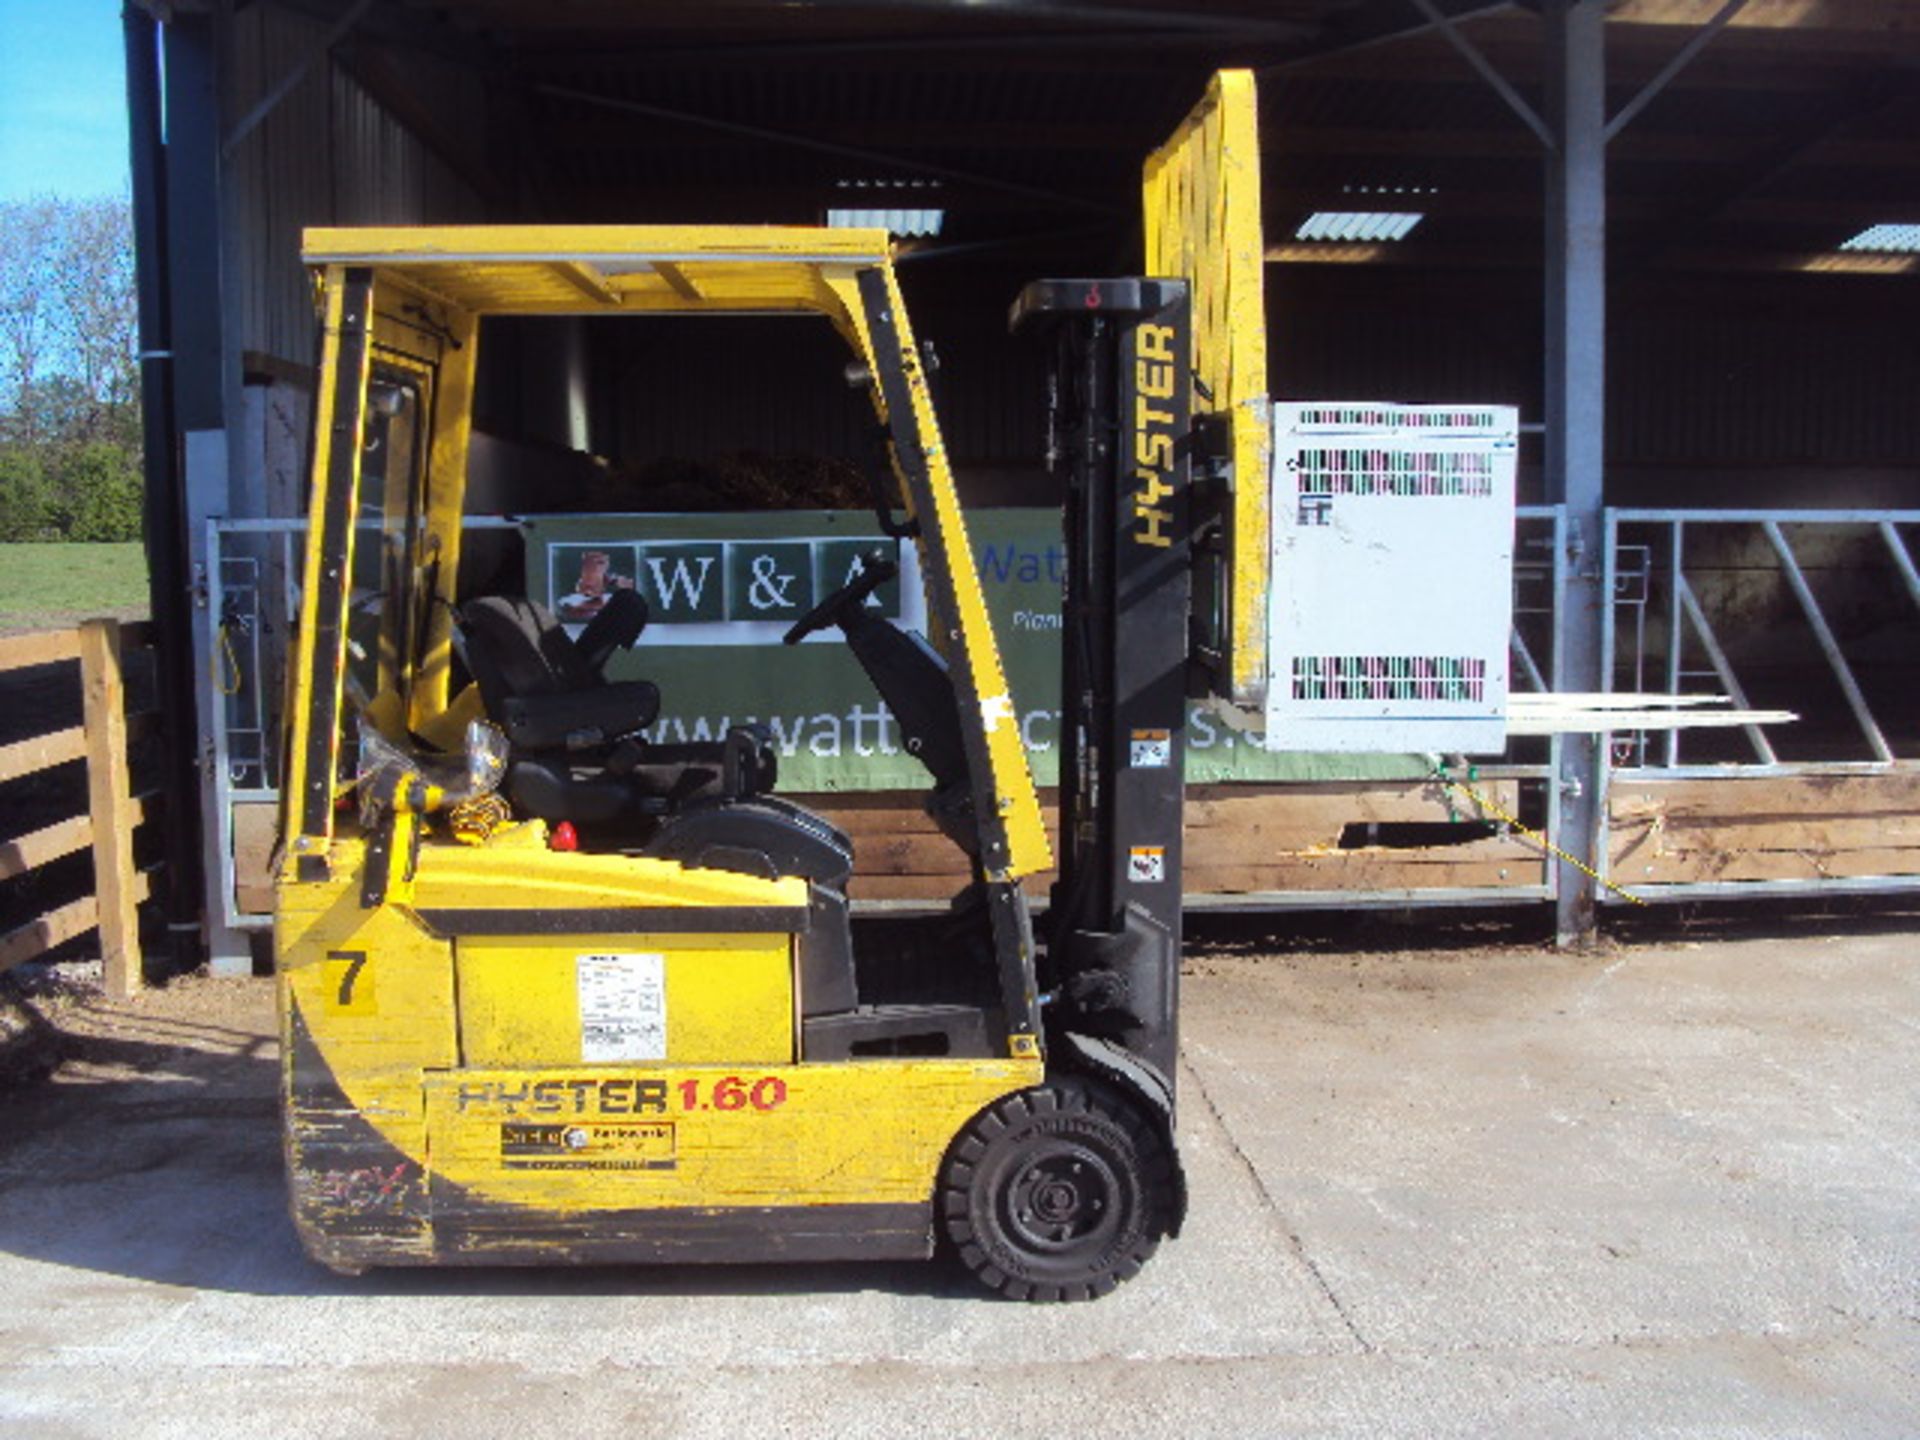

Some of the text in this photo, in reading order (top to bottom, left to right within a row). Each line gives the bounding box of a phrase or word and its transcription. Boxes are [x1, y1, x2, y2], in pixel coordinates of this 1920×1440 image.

[1135, 322, 1175, 547] HYSTER
[646, 556, 714, 611] W
[749, 553, 796, 610] &
[978, 543, 1066, 584] Wat
[327, 950, 367, 1006] 7
[457, 1076, 787, 1113] HYSTER 1.60
